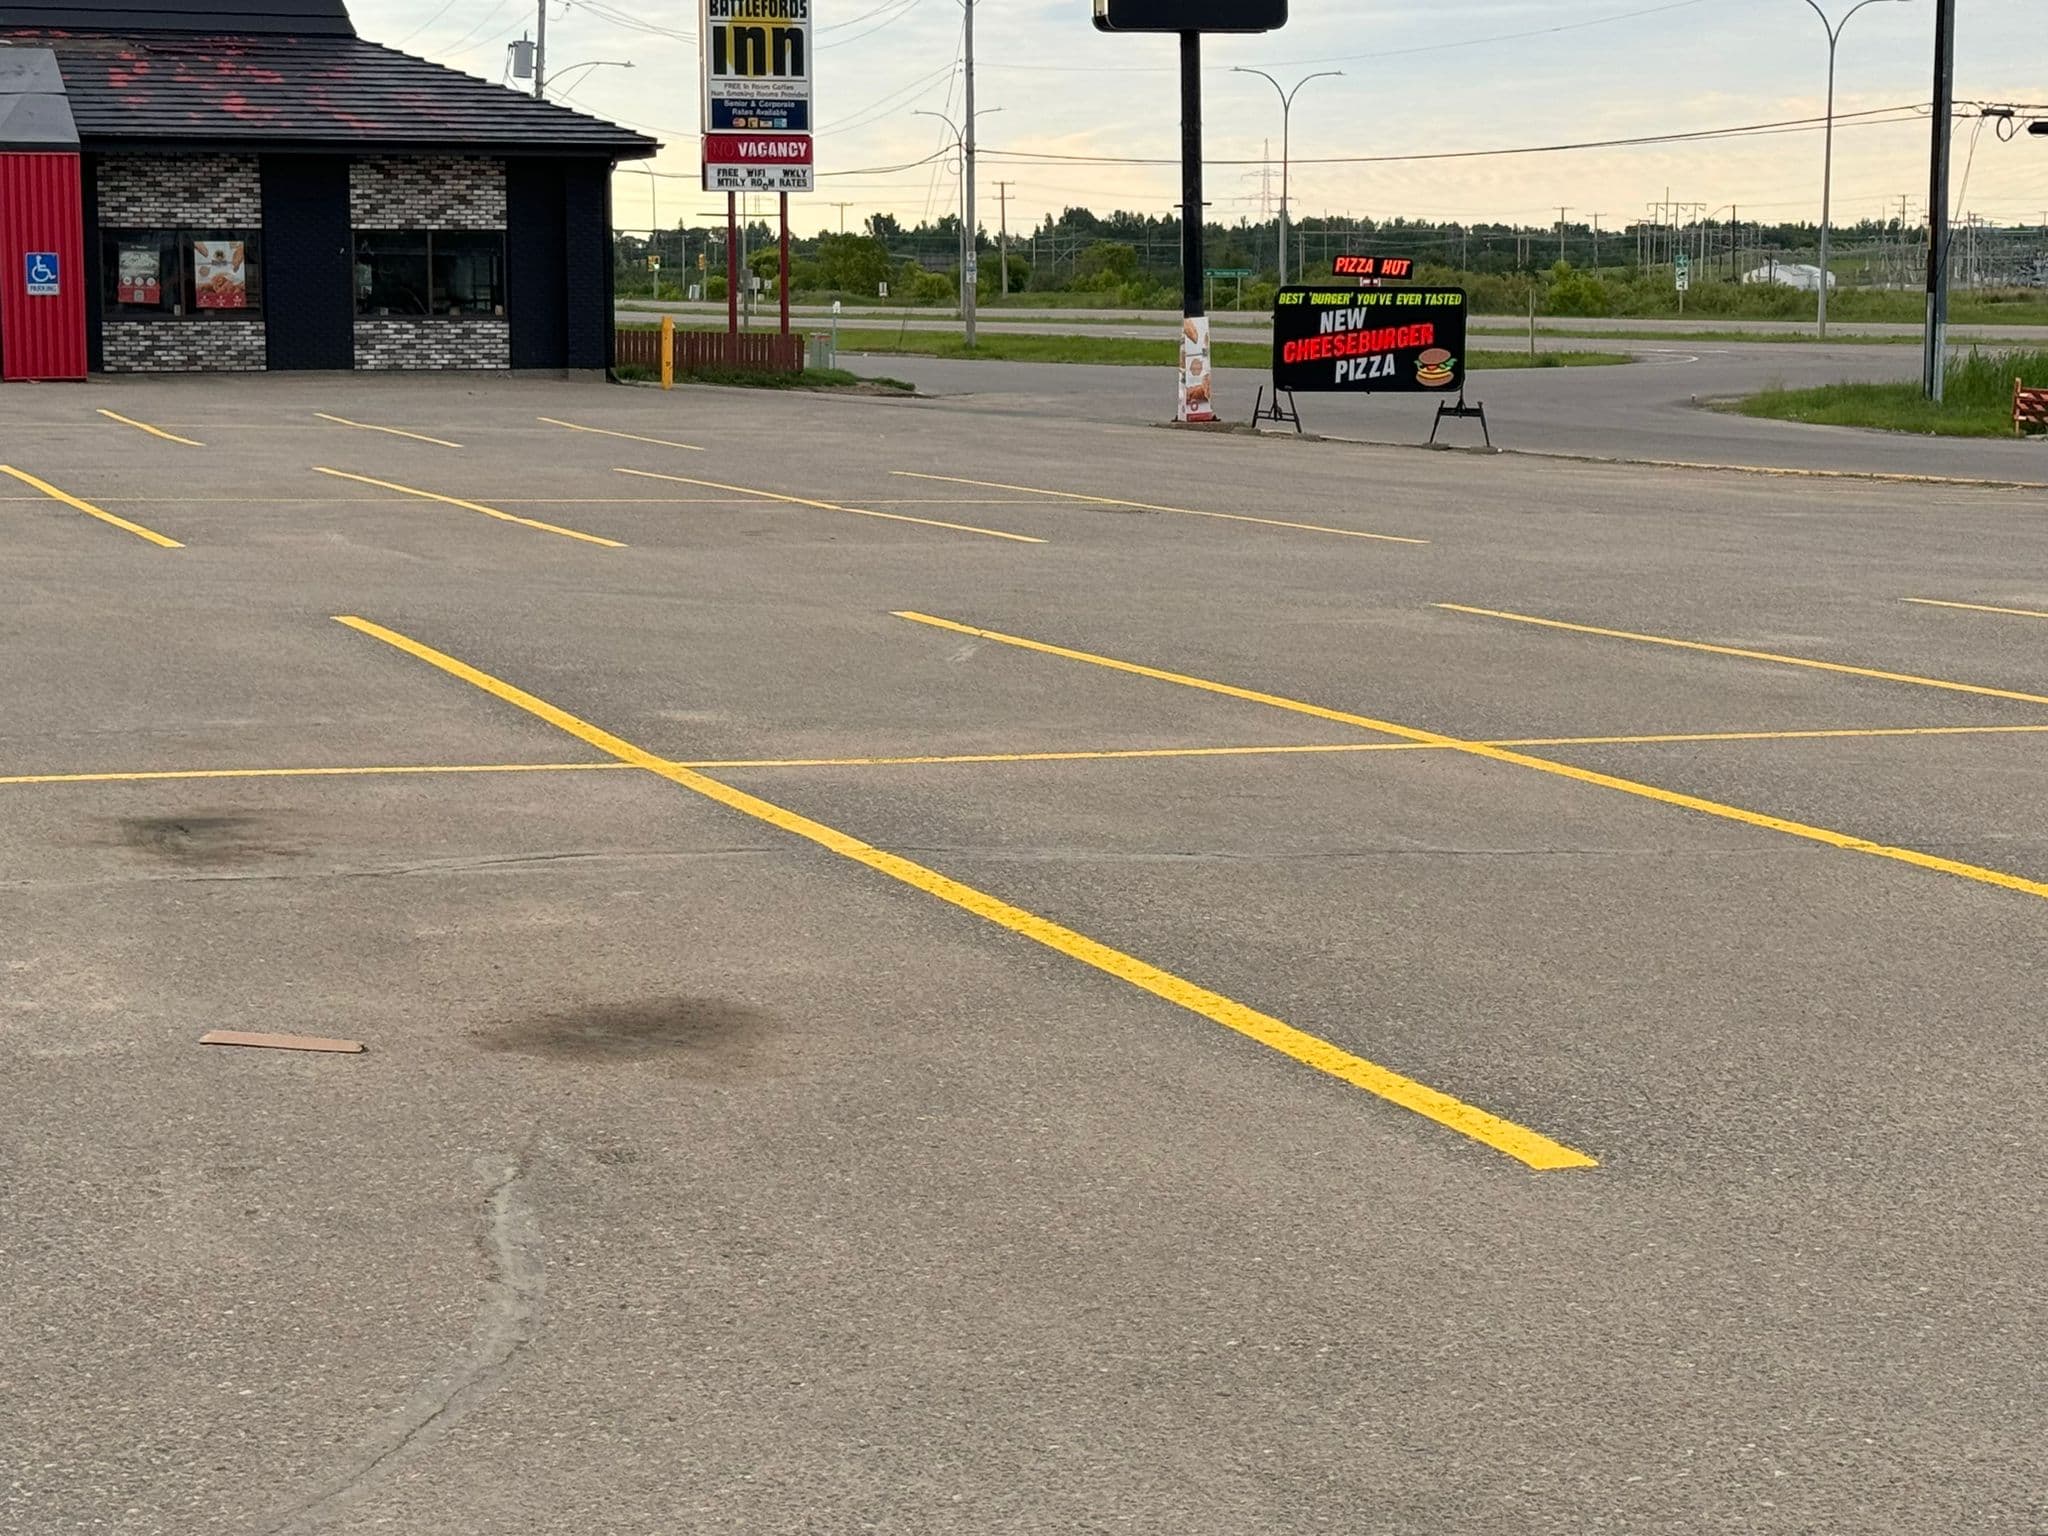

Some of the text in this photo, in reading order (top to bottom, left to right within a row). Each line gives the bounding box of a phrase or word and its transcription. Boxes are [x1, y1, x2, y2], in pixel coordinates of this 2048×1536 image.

[709, 0, 808, 19] BATTLEFORDS
[756, 108, 788, 116] Available
[759, 100, 795, 108] Corporate
[738, 141, 807, 158] VACANCY
[717, 168, 807, 178] FREE WIFI WKLY
[717, 178, 746, 187] MTHLY
[780, 179, 807, 188] RATES
[1335, 257, 1411, 276] PIZZA HUT
[1278, 292, 1463, 306] BEST 'BURGER' YOU'VE EVER TASTED
[1319, 307, 1368, 334] NEW
[1282, 322, 1435, 364] CHEESEBURGER
[1334, 353, 1396, 384] PIZZA
